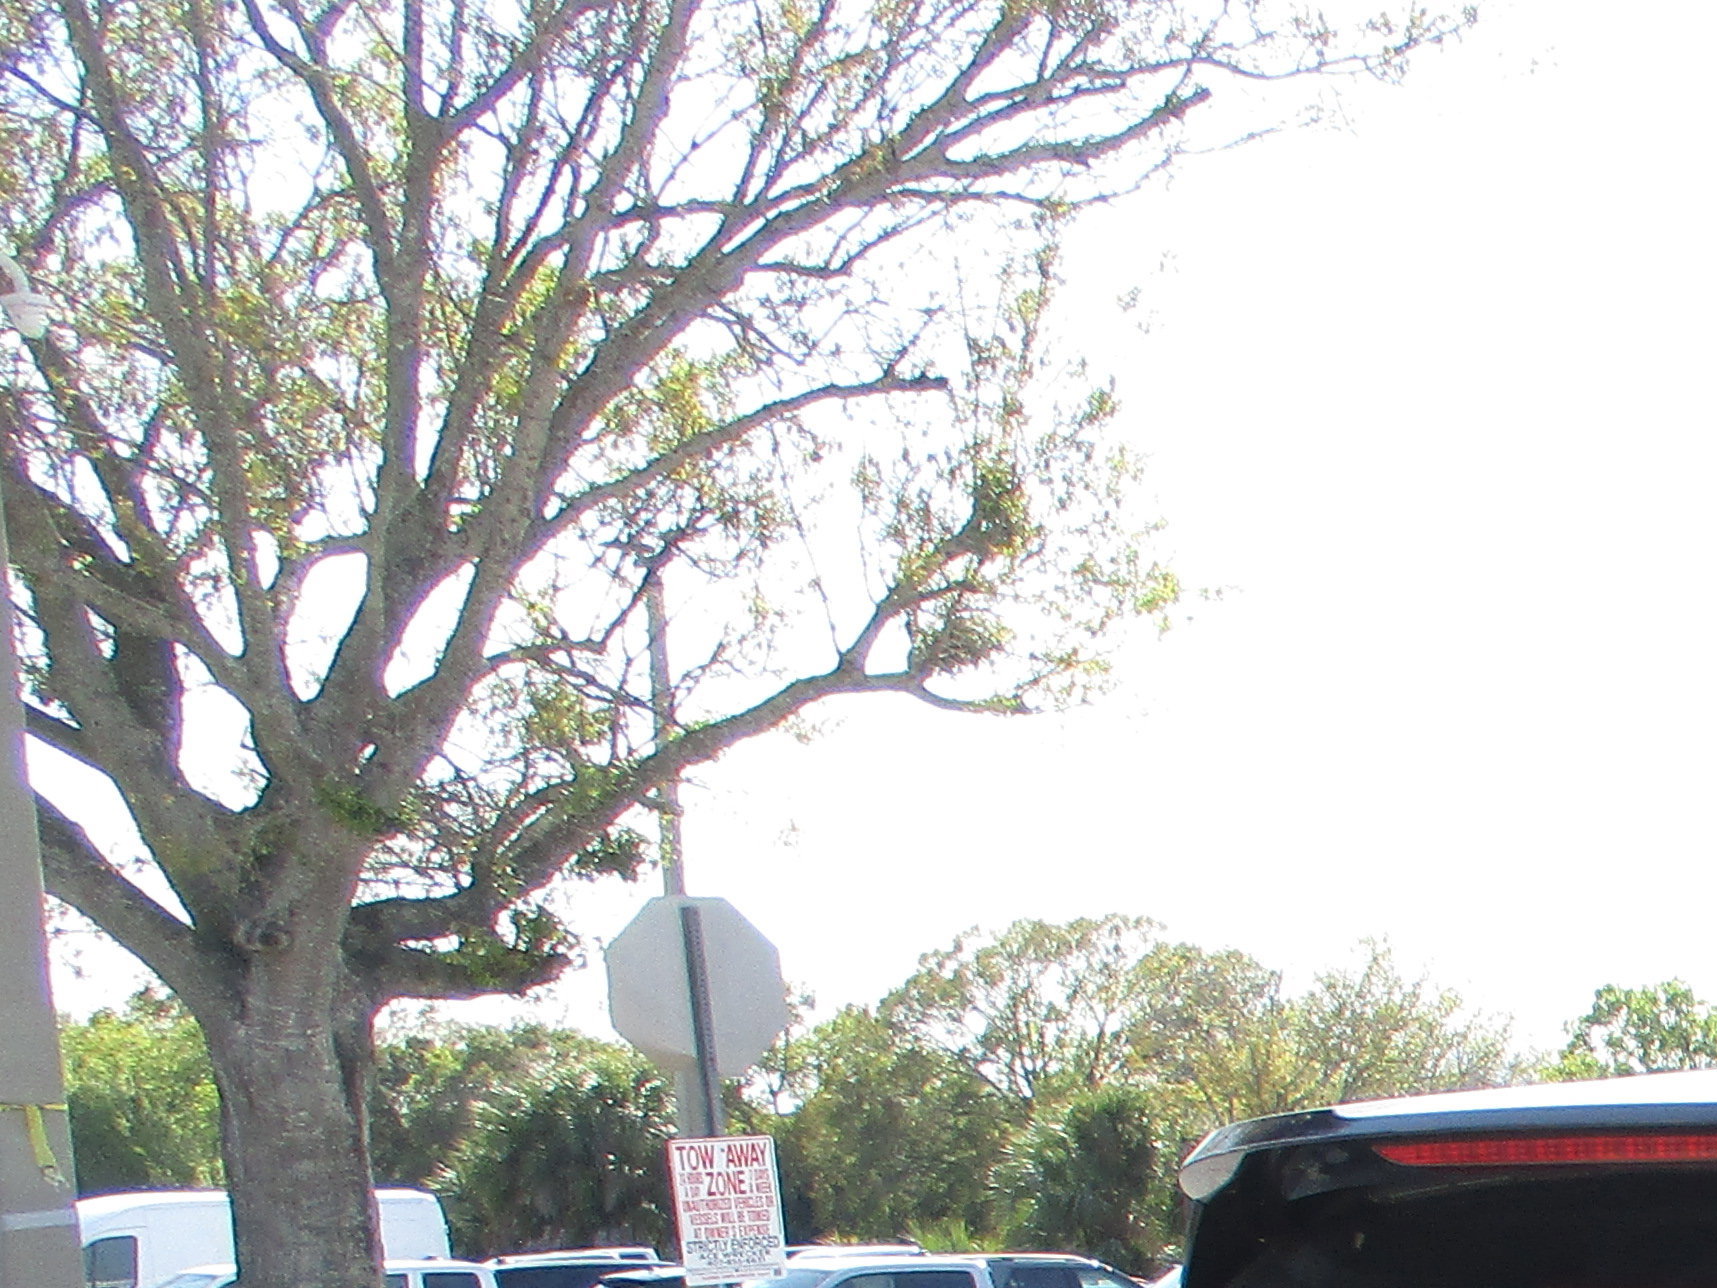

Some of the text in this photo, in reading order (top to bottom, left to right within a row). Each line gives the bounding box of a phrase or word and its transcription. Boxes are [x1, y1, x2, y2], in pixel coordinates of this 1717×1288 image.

[675, 1142, 767, 1171] TOW AWAY
[705, 1170, 748, 1197] ZONE
[686, 1235, 781, 1254] STRICTLY ENFORCED
